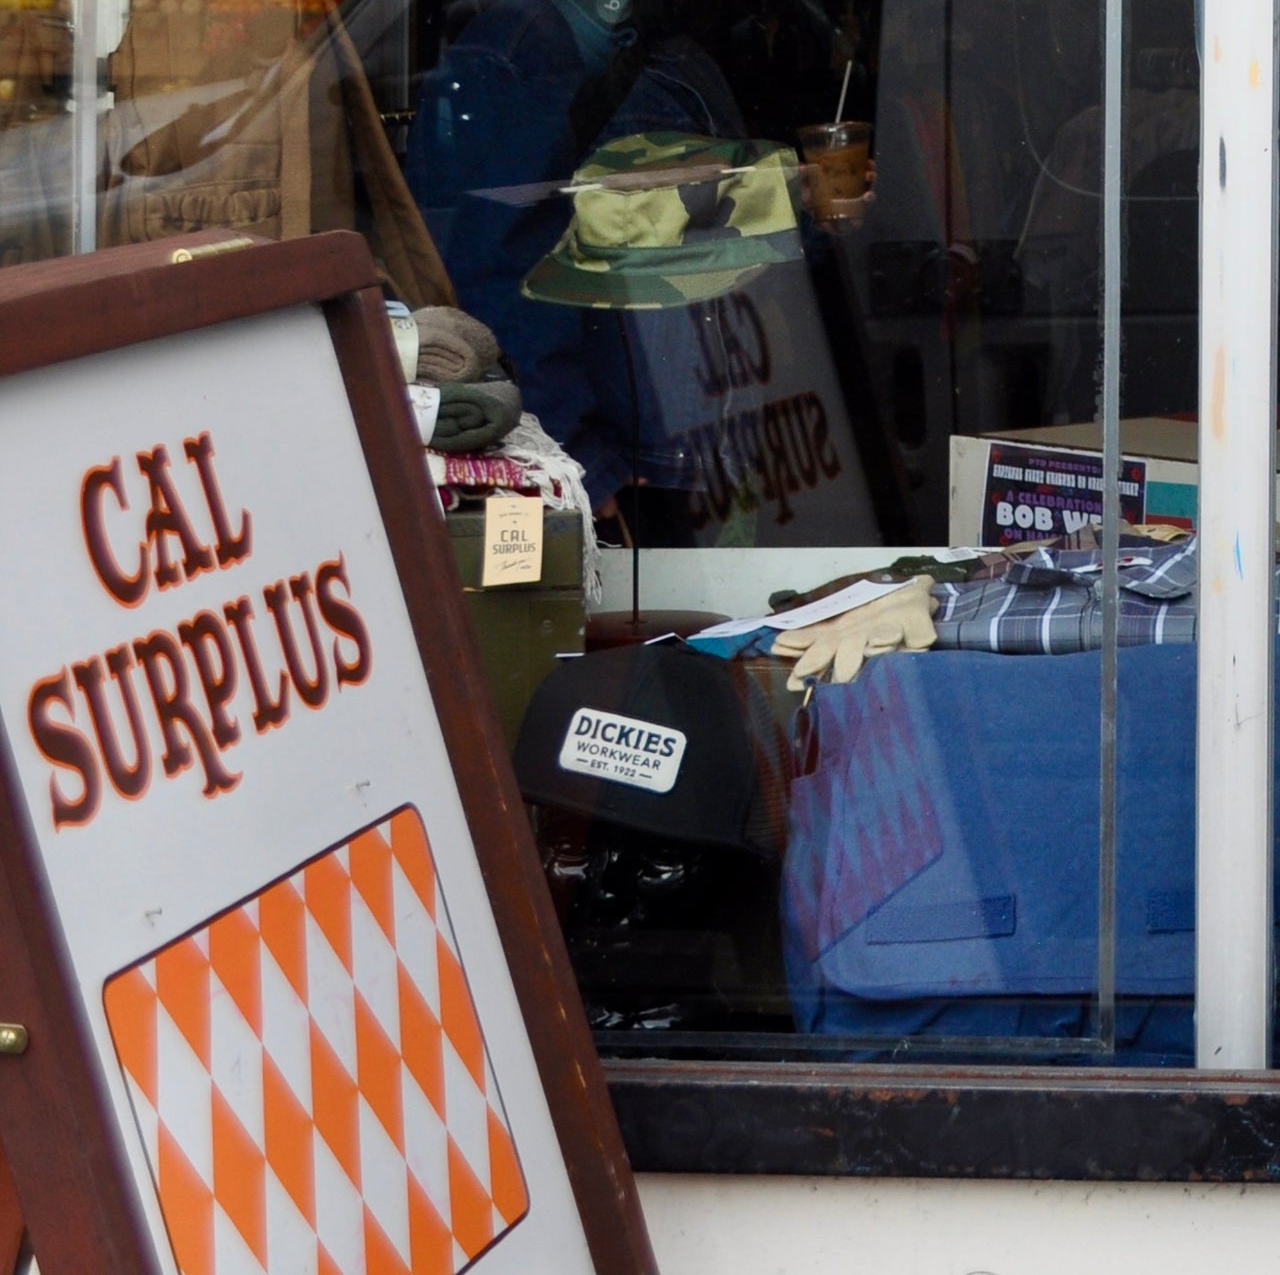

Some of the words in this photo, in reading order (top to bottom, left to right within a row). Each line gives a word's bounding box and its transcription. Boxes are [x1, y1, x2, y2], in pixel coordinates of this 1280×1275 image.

[80, 429, 253, 609] CAL
[996, 501, 1053, 531] BOB
[492, 542, 537, 556] SURPLUS
[500, 529, 528, 543] CAL
[27, 549, 374, 833] SURPLUS
[574, 715, 677, 757] DICKIES
[576, 741, 662, 771] WORKWEAR
[590, 759, 609, 771] EST.
[614, 765, 637, 778] 1922
